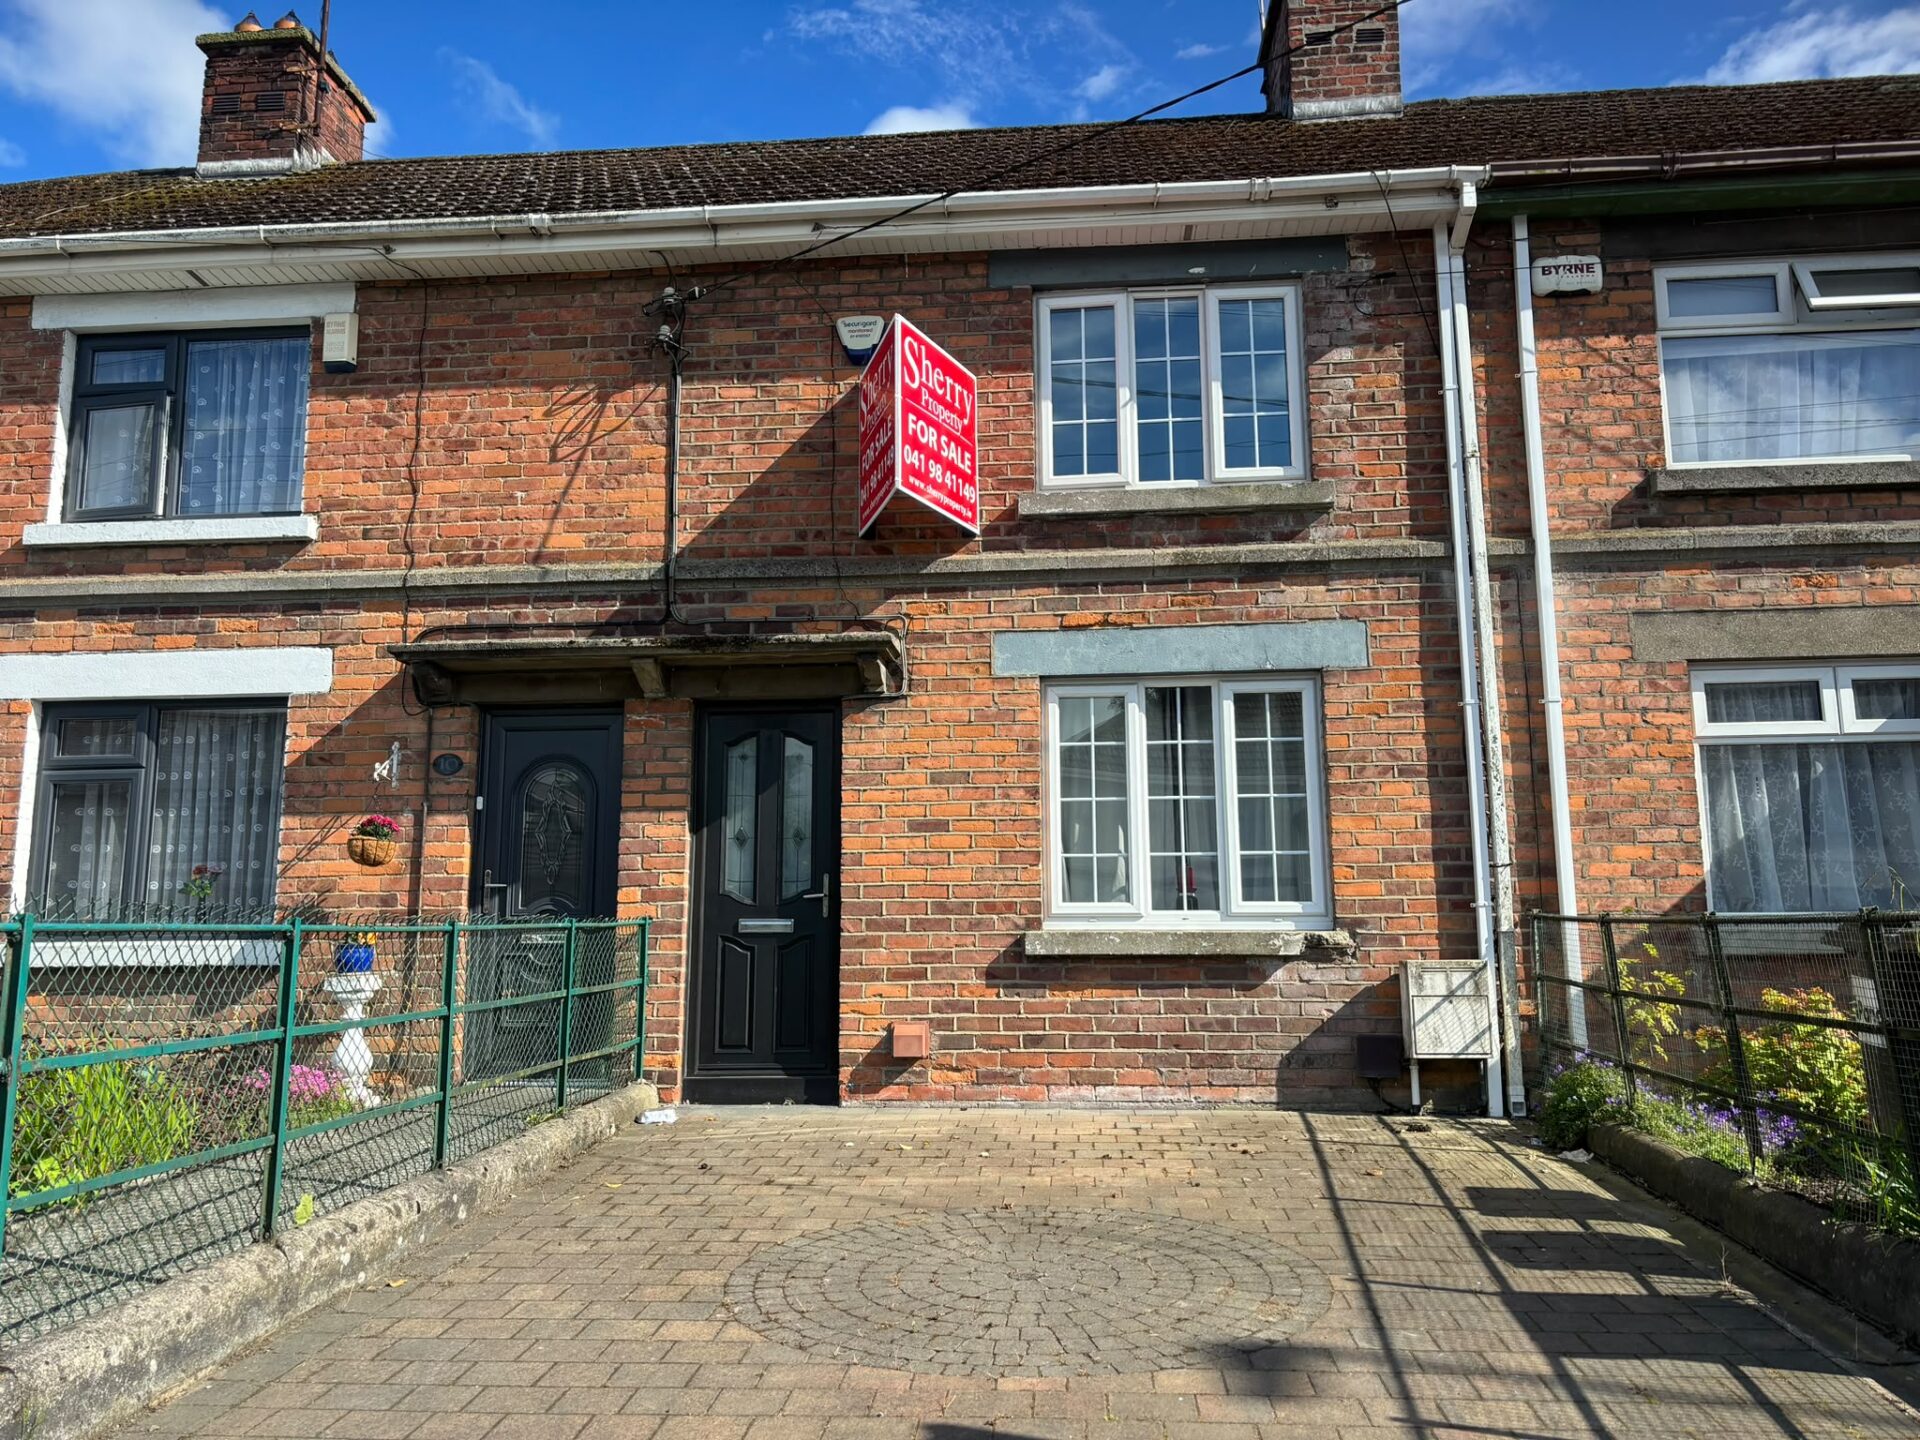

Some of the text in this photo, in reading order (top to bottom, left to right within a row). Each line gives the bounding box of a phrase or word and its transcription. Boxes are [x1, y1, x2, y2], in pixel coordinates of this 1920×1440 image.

[1541, 263, 1596, 276] BYRNE
[861, 344, 894, 433] Sherry
[904, 336, 973, 425] Sherry
[921, 386, 963, 435] Property
[862, 414, 893, 476] FOR SALE
[908, 412, 972, 475] FOR SALE
[903, 444, 976, 505] 041 98 41149
[439, 757, 460, 772] 10
